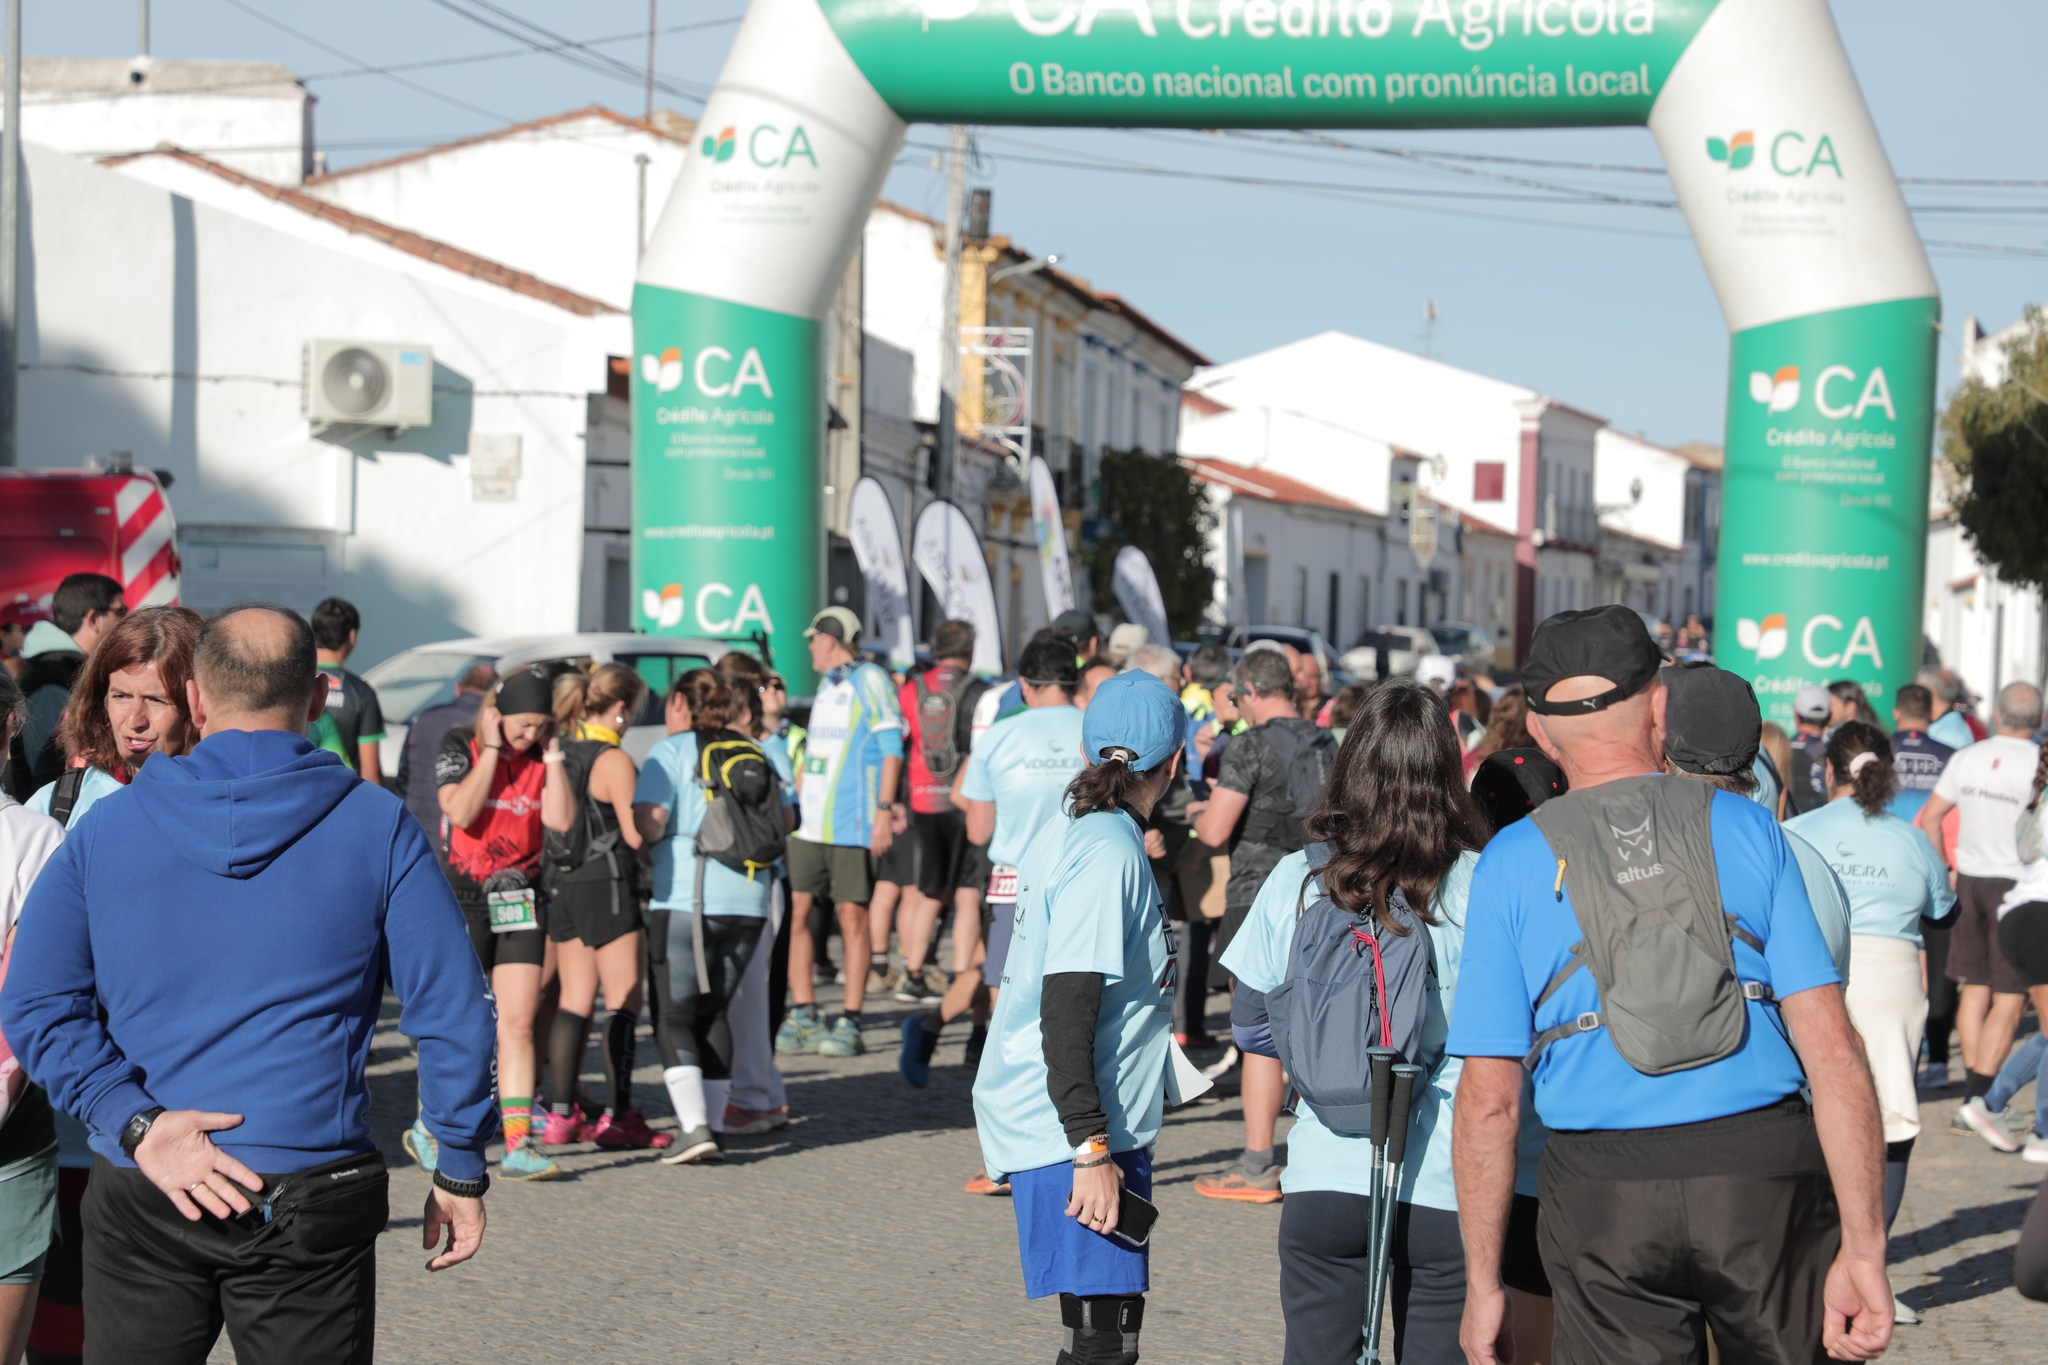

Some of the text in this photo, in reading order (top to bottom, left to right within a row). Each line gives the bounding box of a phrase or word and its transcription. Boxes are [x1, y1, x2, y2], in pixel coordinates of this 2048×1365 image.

[1009, 62, 1652, 103] O Banco nacional com pronúncia local
[749, 124, 818, 168] CA
[1771, 130, 1843, 179] CA
[694, 346, 774, 399] CA
[1815, 365, 1896, 421] CA
[1766, 428, 1895, 450] Crédito Agrícola
[695, 582, 774, 634] CA
[1803, 614, 1883, 670] CA
[1617, 863, 1664, 884] altus
